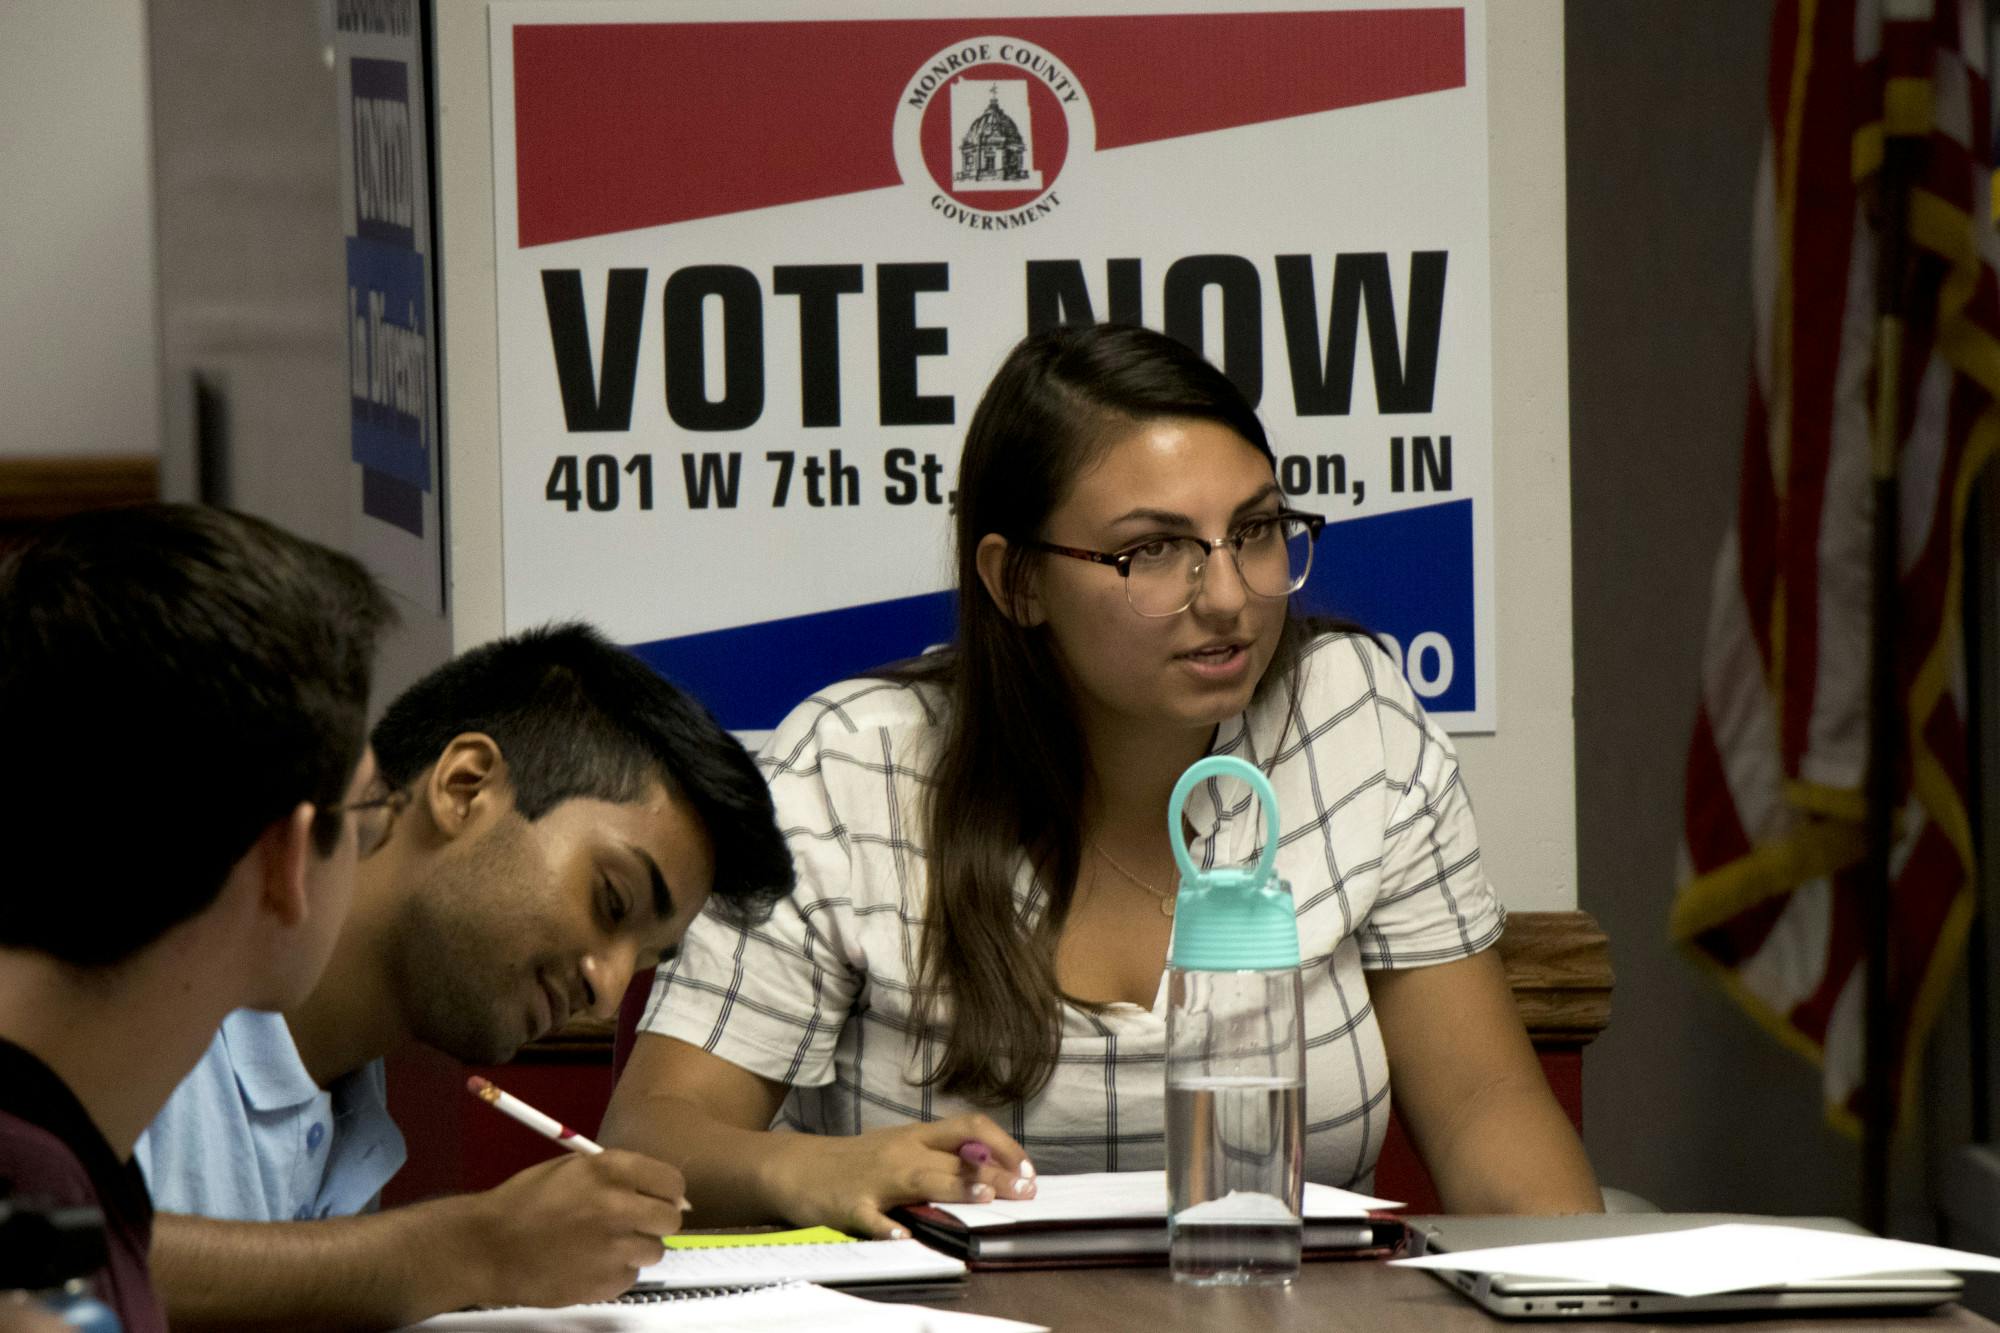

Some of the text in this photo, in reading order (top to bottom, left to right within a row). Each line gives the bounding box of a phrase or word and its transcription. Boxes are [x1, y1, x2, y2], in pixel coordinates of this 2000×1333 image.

[908, 44, 1080, 110] MONROE COUNTY
[931, 191, 1062, 231] GOVERNMENT
[541, 263, 955, 433] VOTE
[545, 454, 653, 512] 401
[681, 453, 742, 509] W
[766, 449, 860, 507] 7th
[1274, 453, 1365, 506] on,
[1390, 435, 1452, 493] IN
